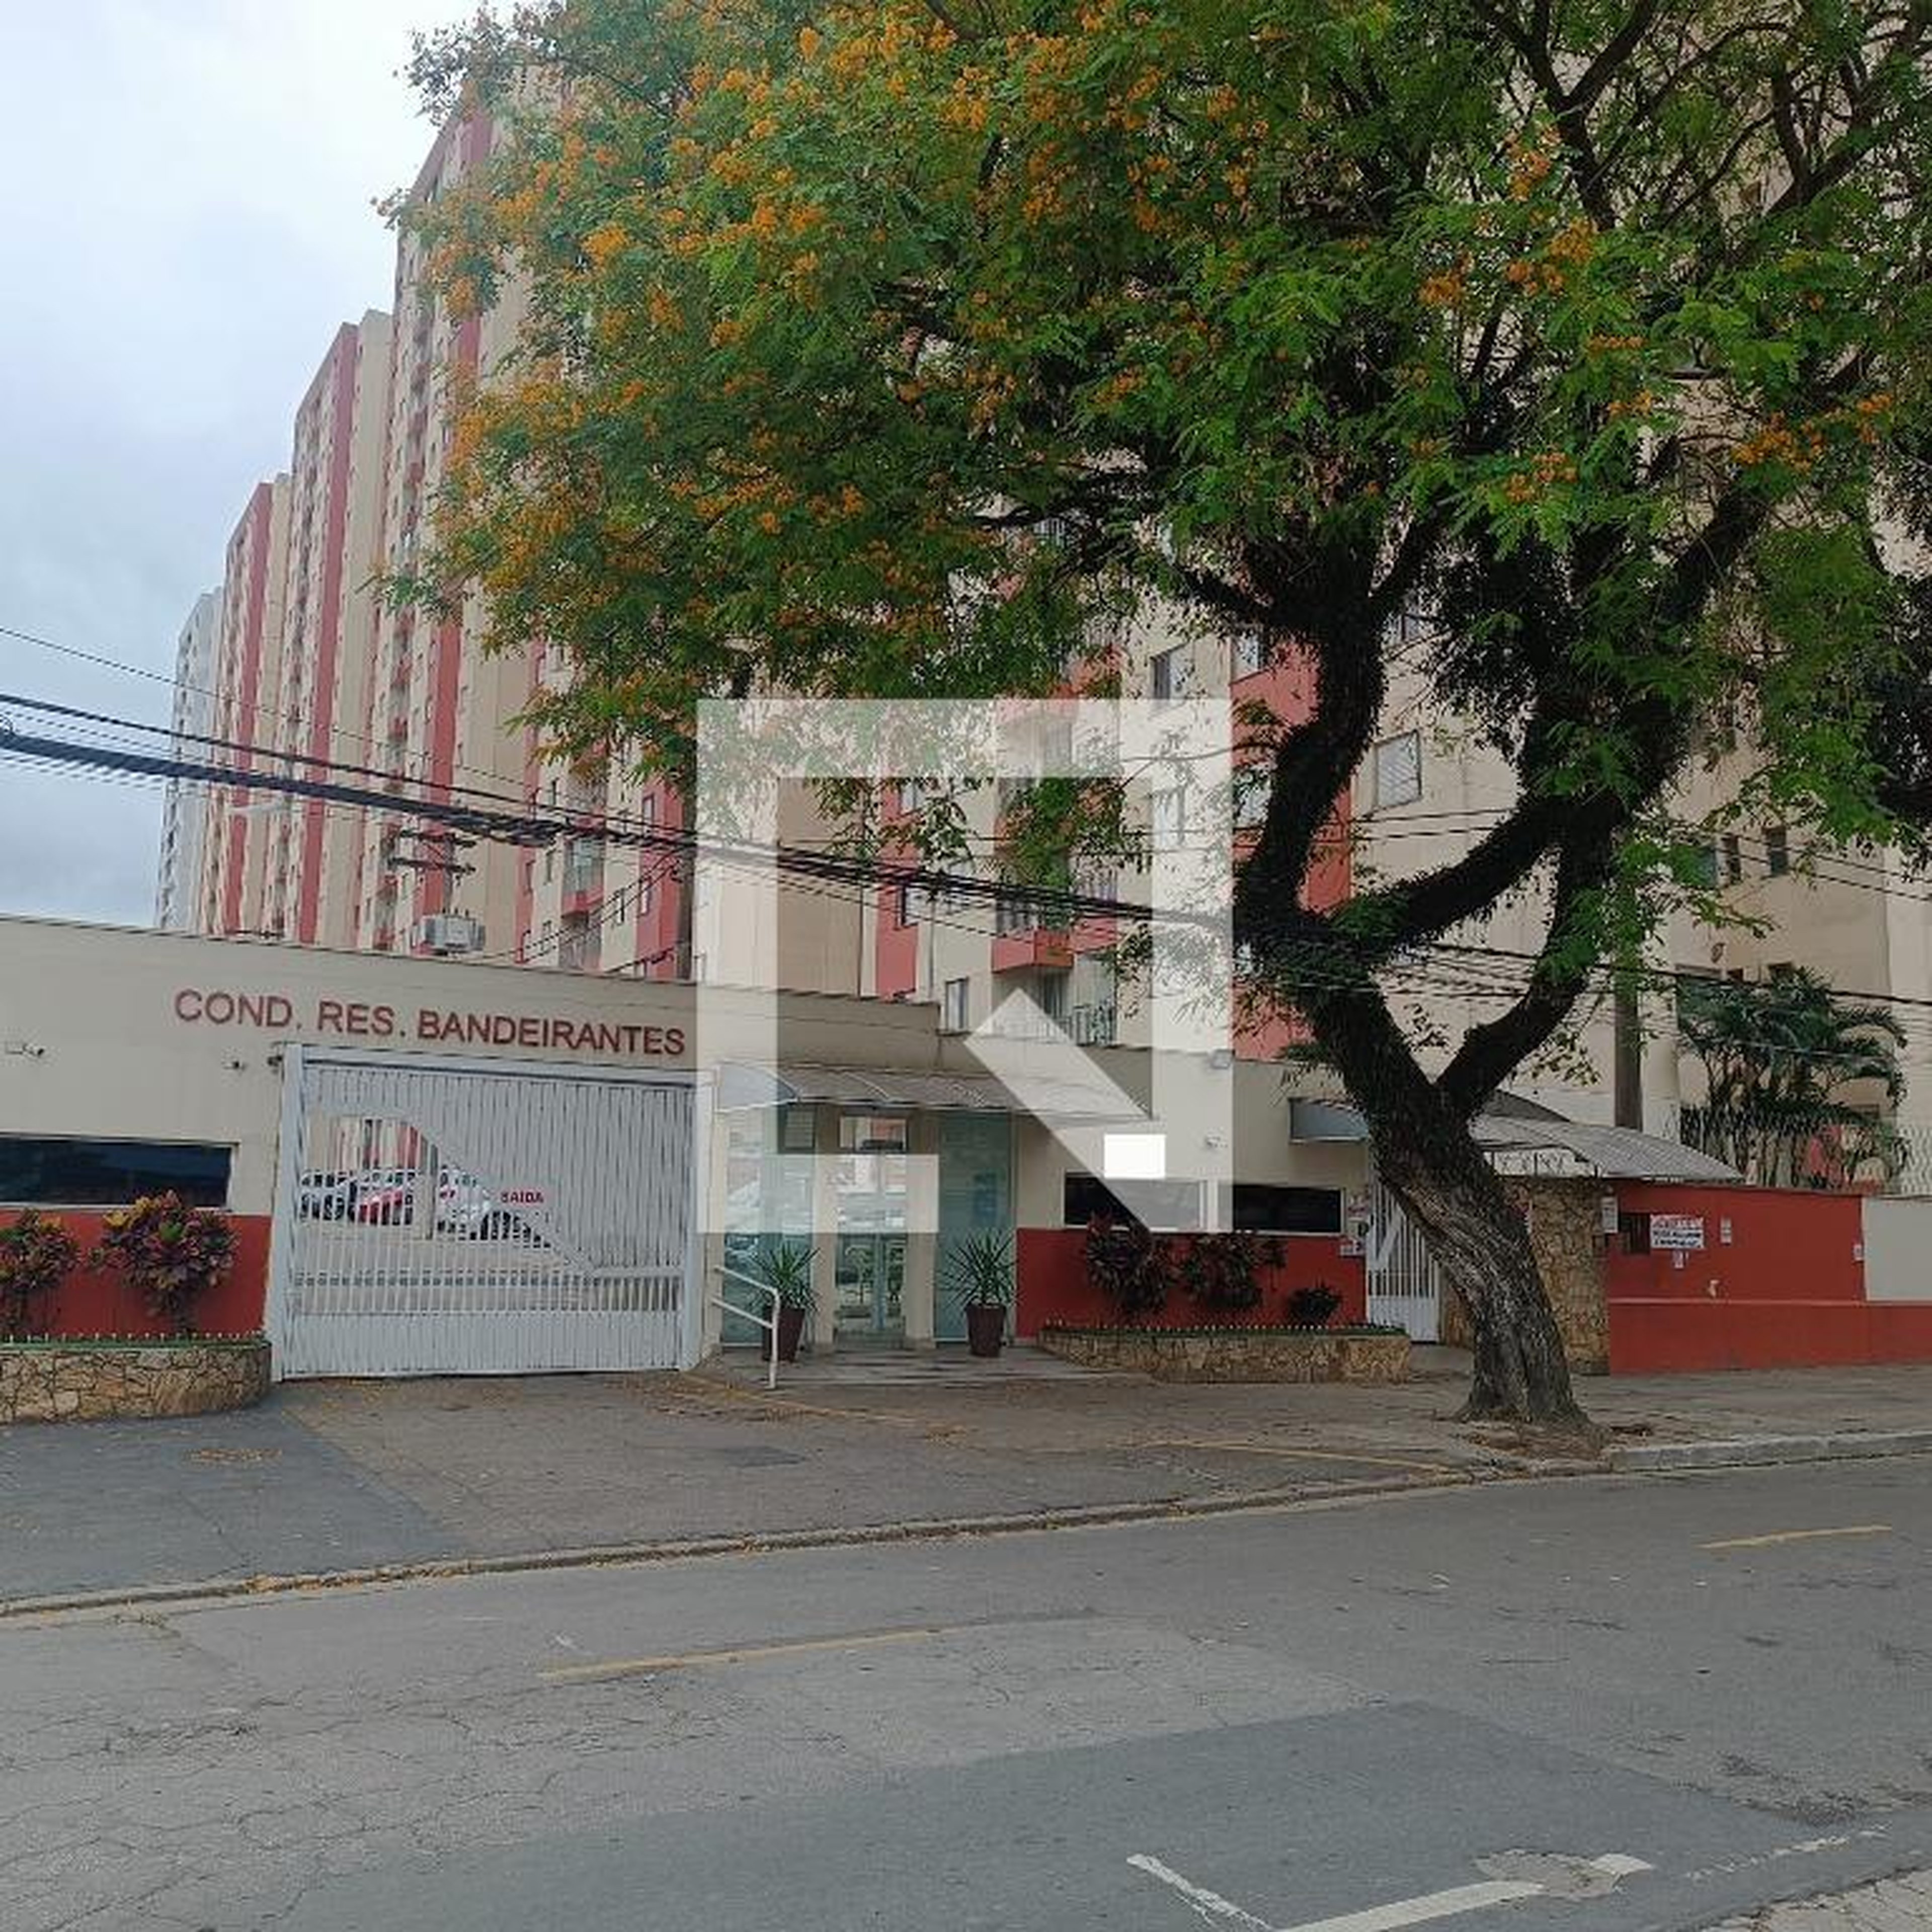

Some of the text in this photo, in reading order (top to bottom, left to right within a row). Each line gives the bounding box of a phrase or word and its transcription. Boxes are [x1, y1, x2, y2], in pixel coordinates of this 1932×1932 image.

[175, 989, 685, 1055] COND. RES. BANDEIRANTES
